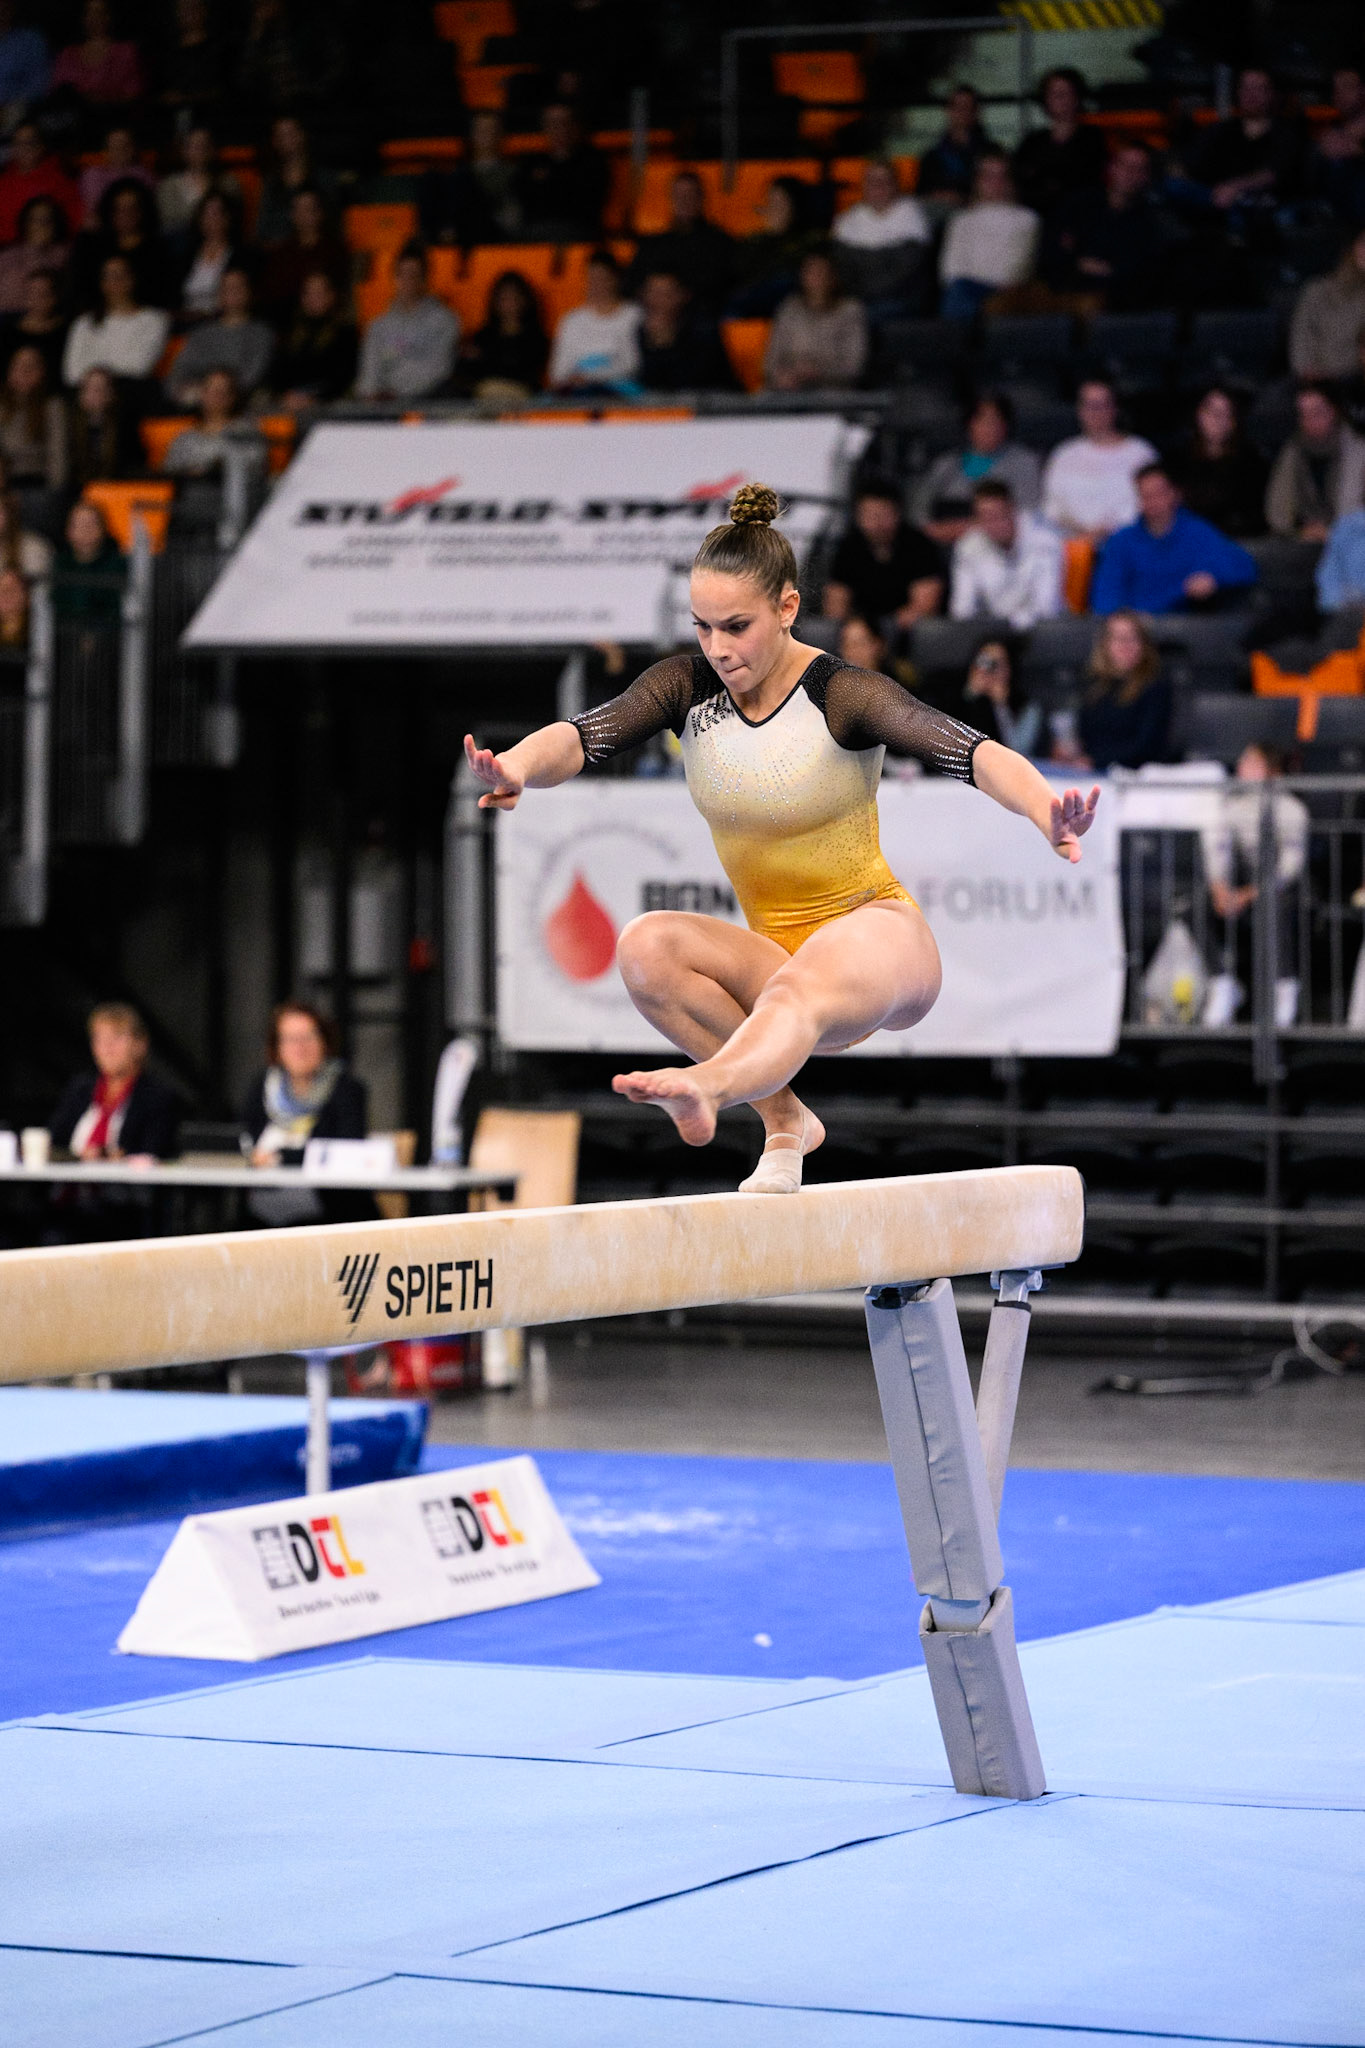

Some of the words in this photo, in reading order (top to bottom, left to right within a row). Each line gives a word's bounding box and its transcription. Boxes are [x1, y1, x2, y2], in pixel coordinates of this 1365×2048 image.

[917, 877, 1096, 923] FORUM
[385, 1259, 493, 1319] SPIETH
[286, 1515, 366, 1583] DTL
